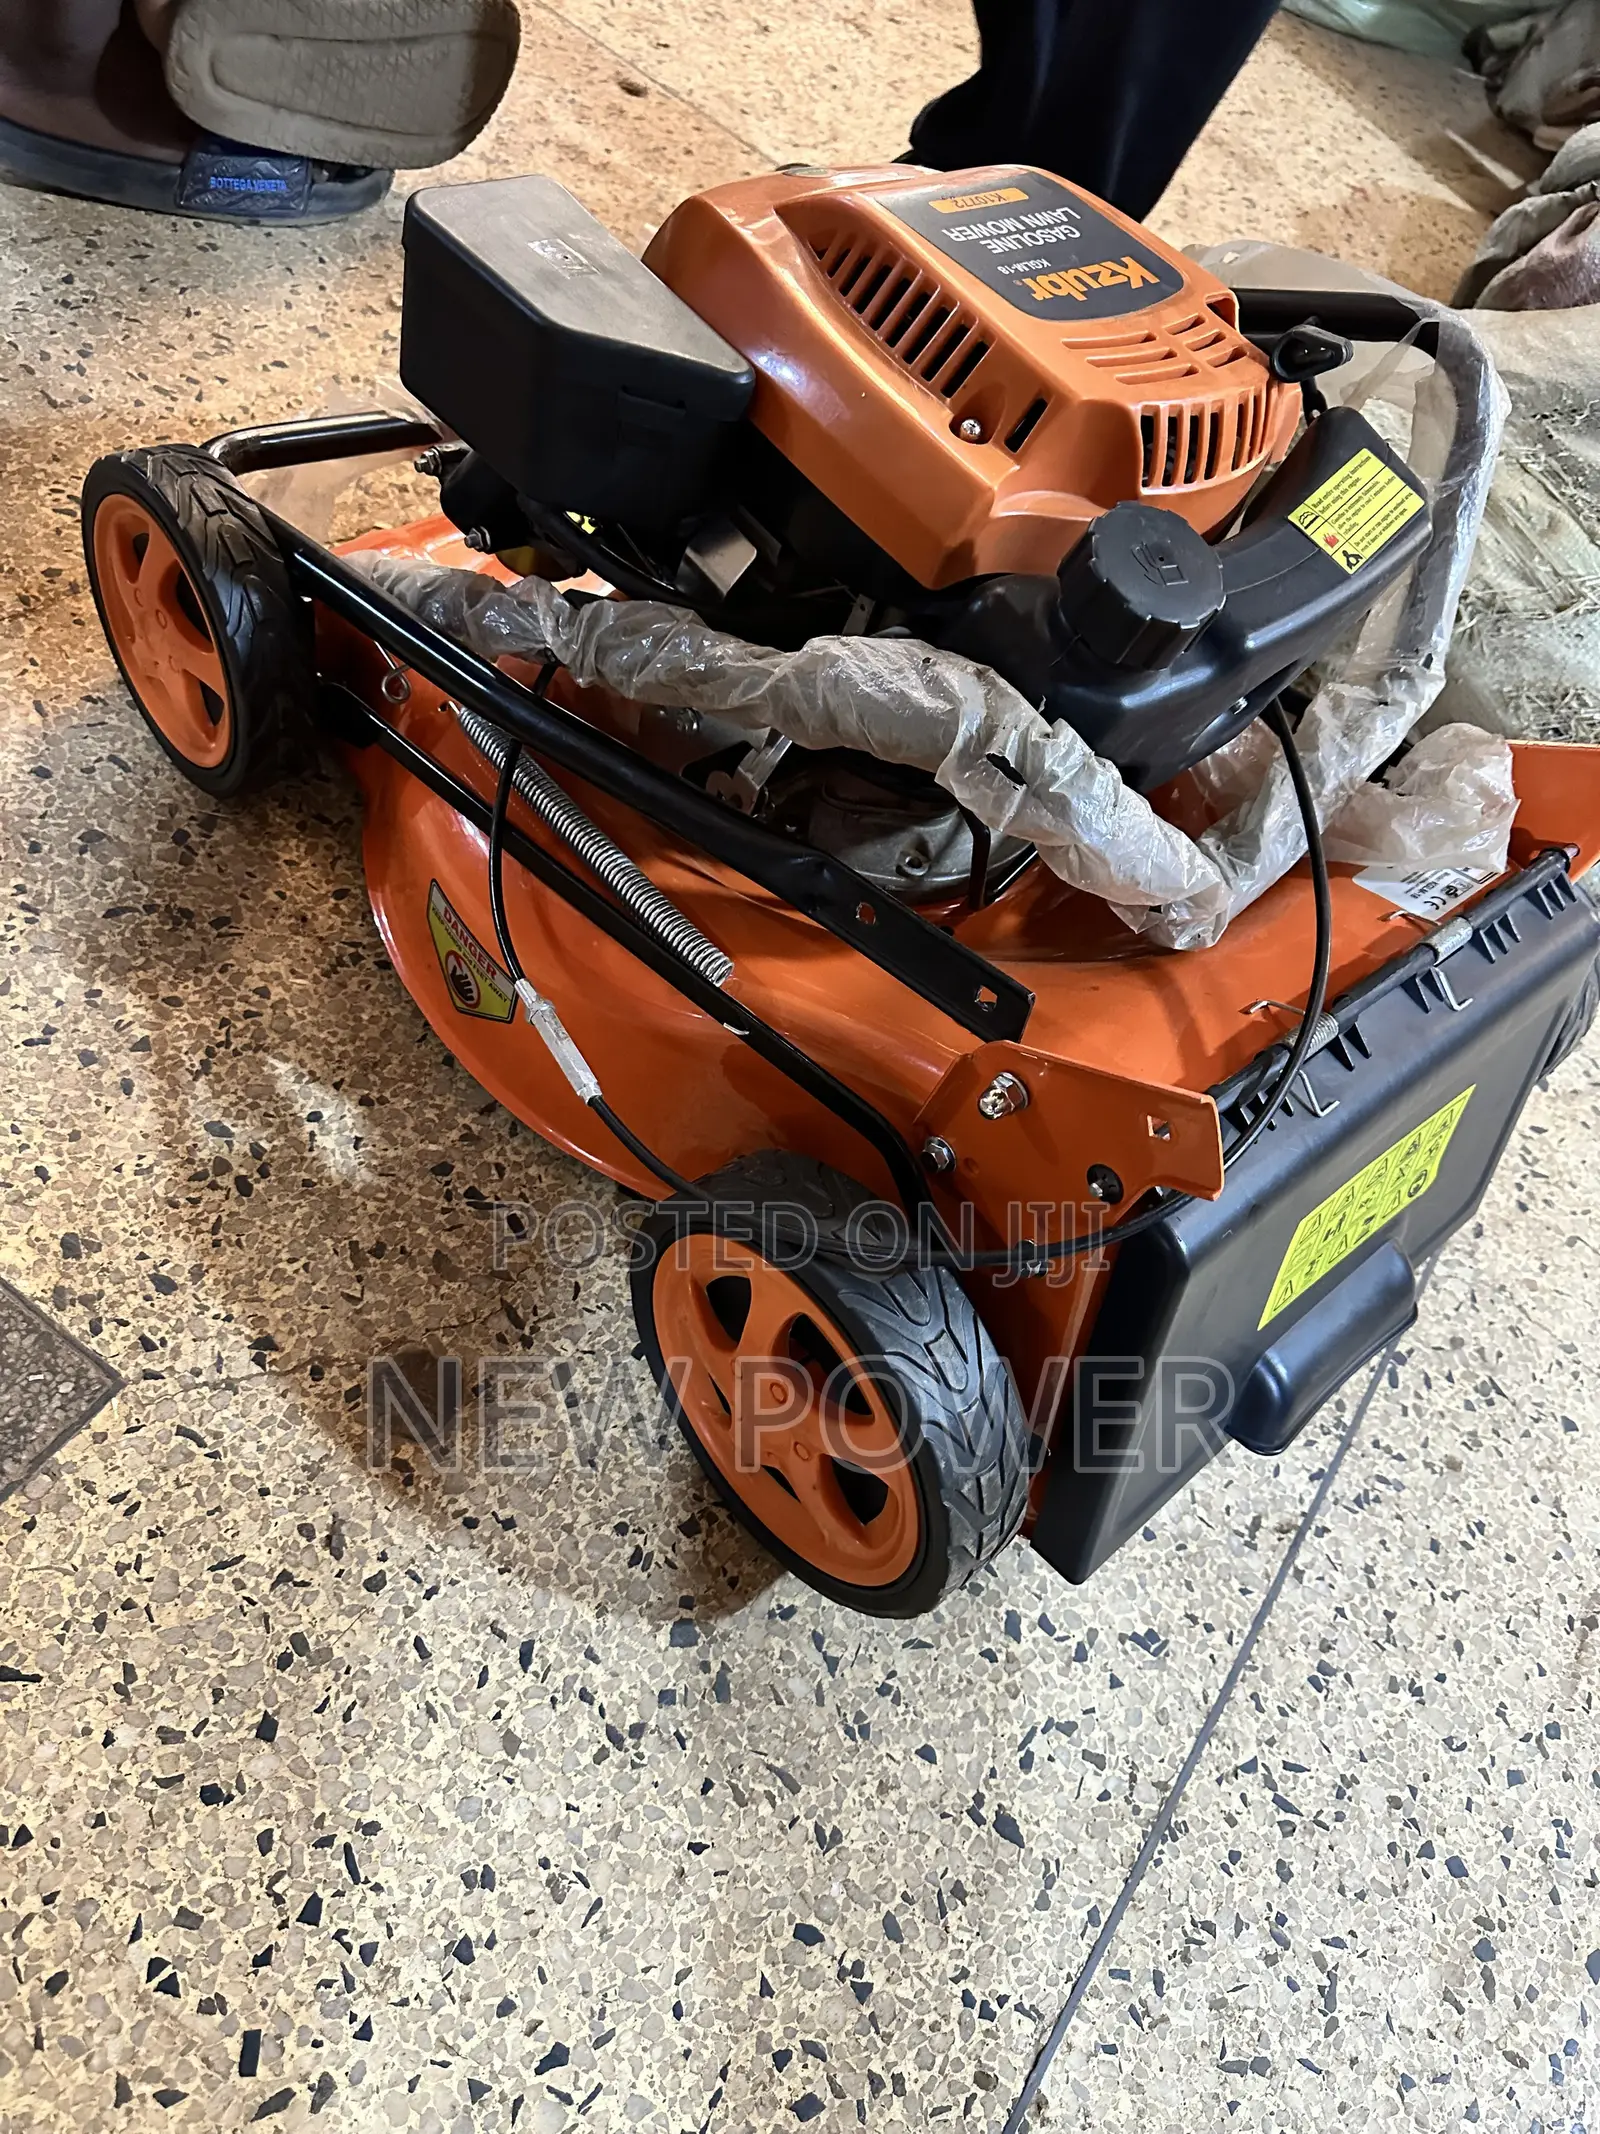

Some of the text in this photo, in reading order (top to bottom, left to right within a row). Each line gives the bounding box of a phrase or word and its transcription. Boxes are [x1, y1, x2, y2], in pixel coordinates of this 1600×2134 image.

[210, 177, 287, 192] BOTTEGA VENETA
[952, 191, 1006, 209] K10772
[941, 206, 1081, 243] LAWN MOWER
[979, 224, 1081, 254] GASOLINE
[996, 258, 1051, 275] KGLM-18
[1021, 256, 1159, 301] Kzubr
[1311, 497, 1324, 509] Read
[443, 907, 497, 980] DANGER
